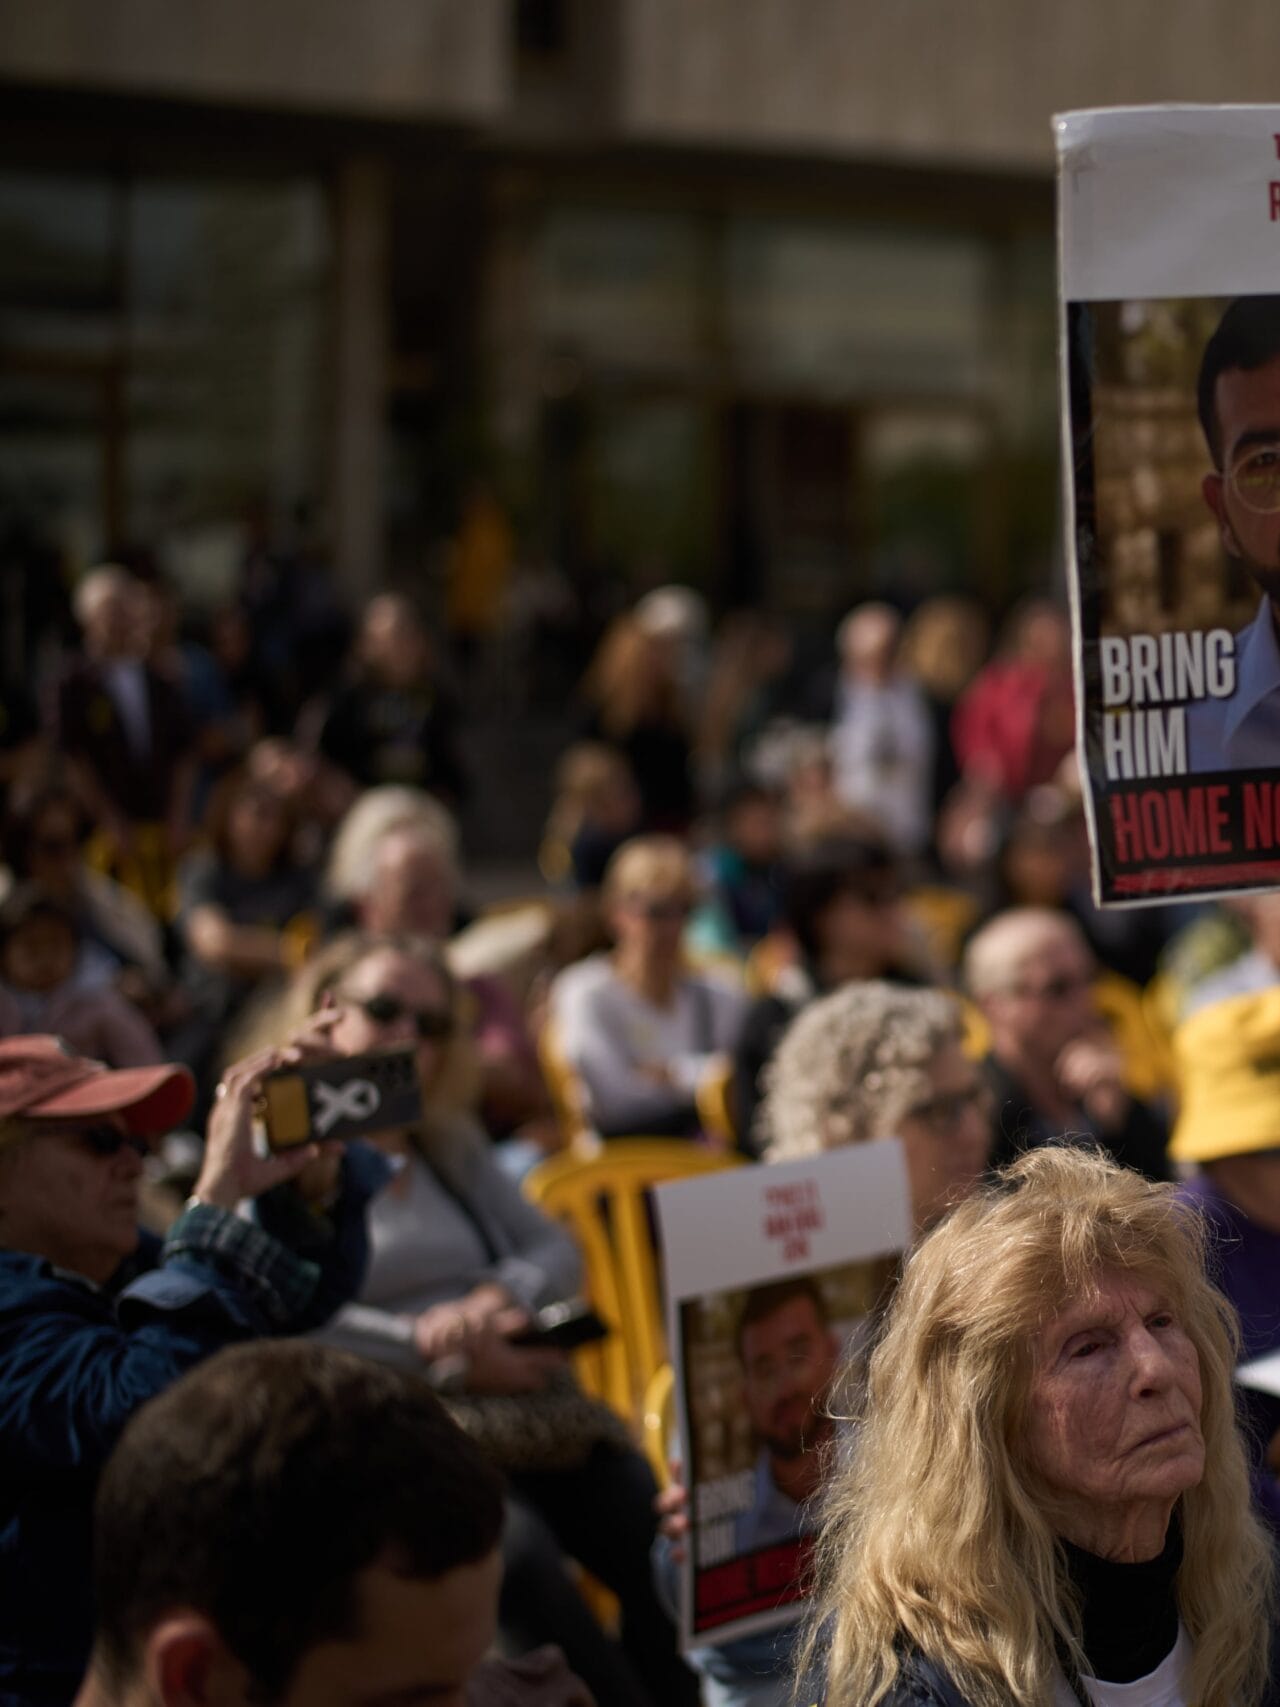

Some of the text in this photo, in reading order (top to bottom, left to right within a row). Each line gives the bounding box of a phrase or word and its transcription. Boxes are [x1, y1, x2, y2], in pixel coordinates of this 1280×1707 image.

[1101, 630, 1236, 704] BRING
[1105, 707, 1188, 780] HIM
[1111, 785, 1232, 864] HOME
